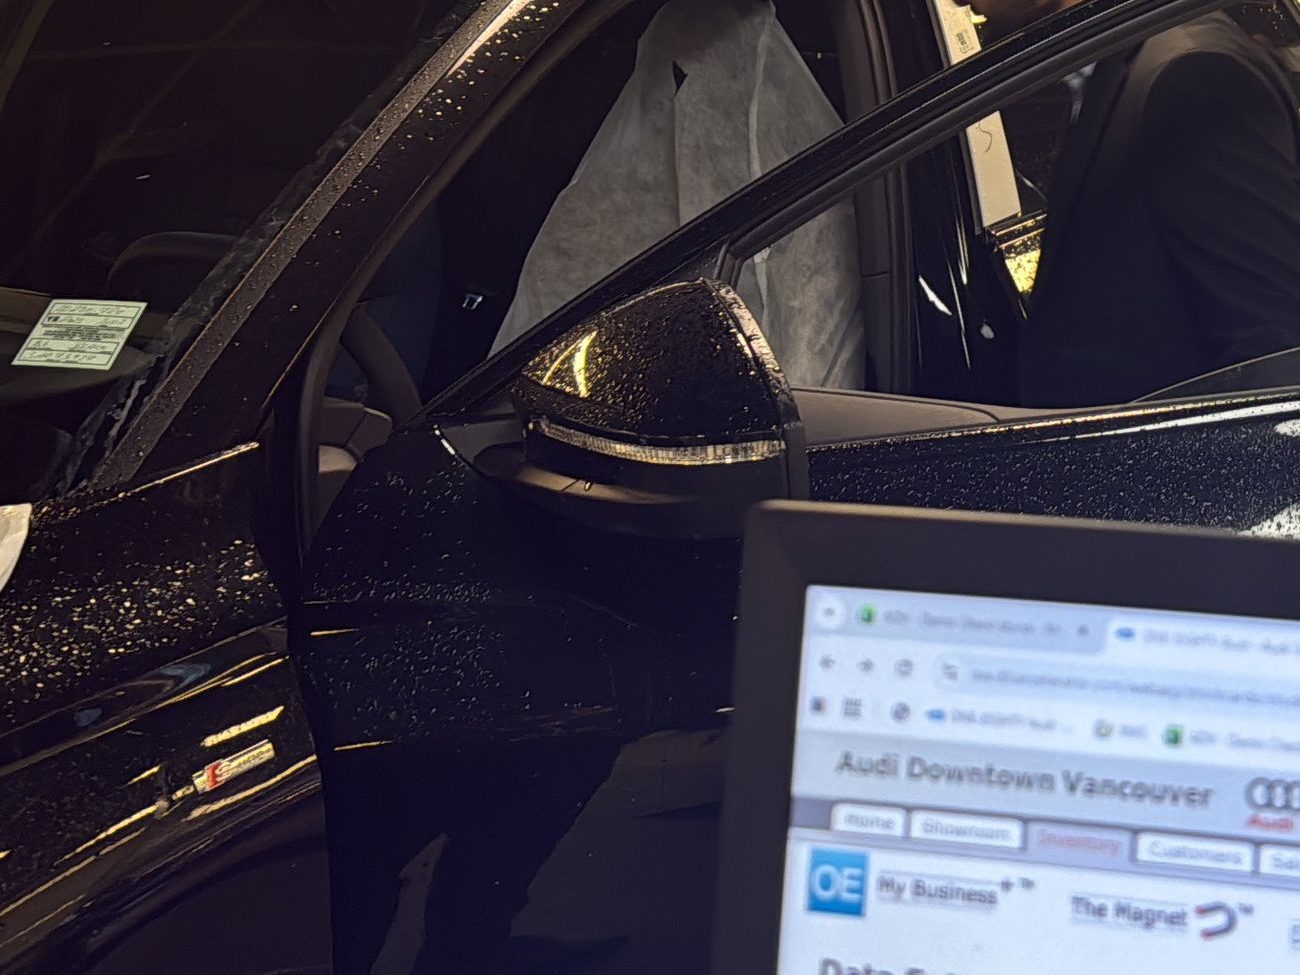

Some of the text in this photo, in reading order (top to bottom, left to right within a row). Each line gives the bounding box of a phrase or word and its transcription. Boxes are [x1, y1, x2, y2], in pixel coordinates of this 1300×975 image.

[835, 750, 1214, 807] Audi Downtown Vancouver
[812, 865, 863, 902] OE
[876, 877, 905, 898] My
[911, 880, 998, 905] Business
[1071, 896, 1109, 918] The
[1113, 901, 1189, 931] Magnet
